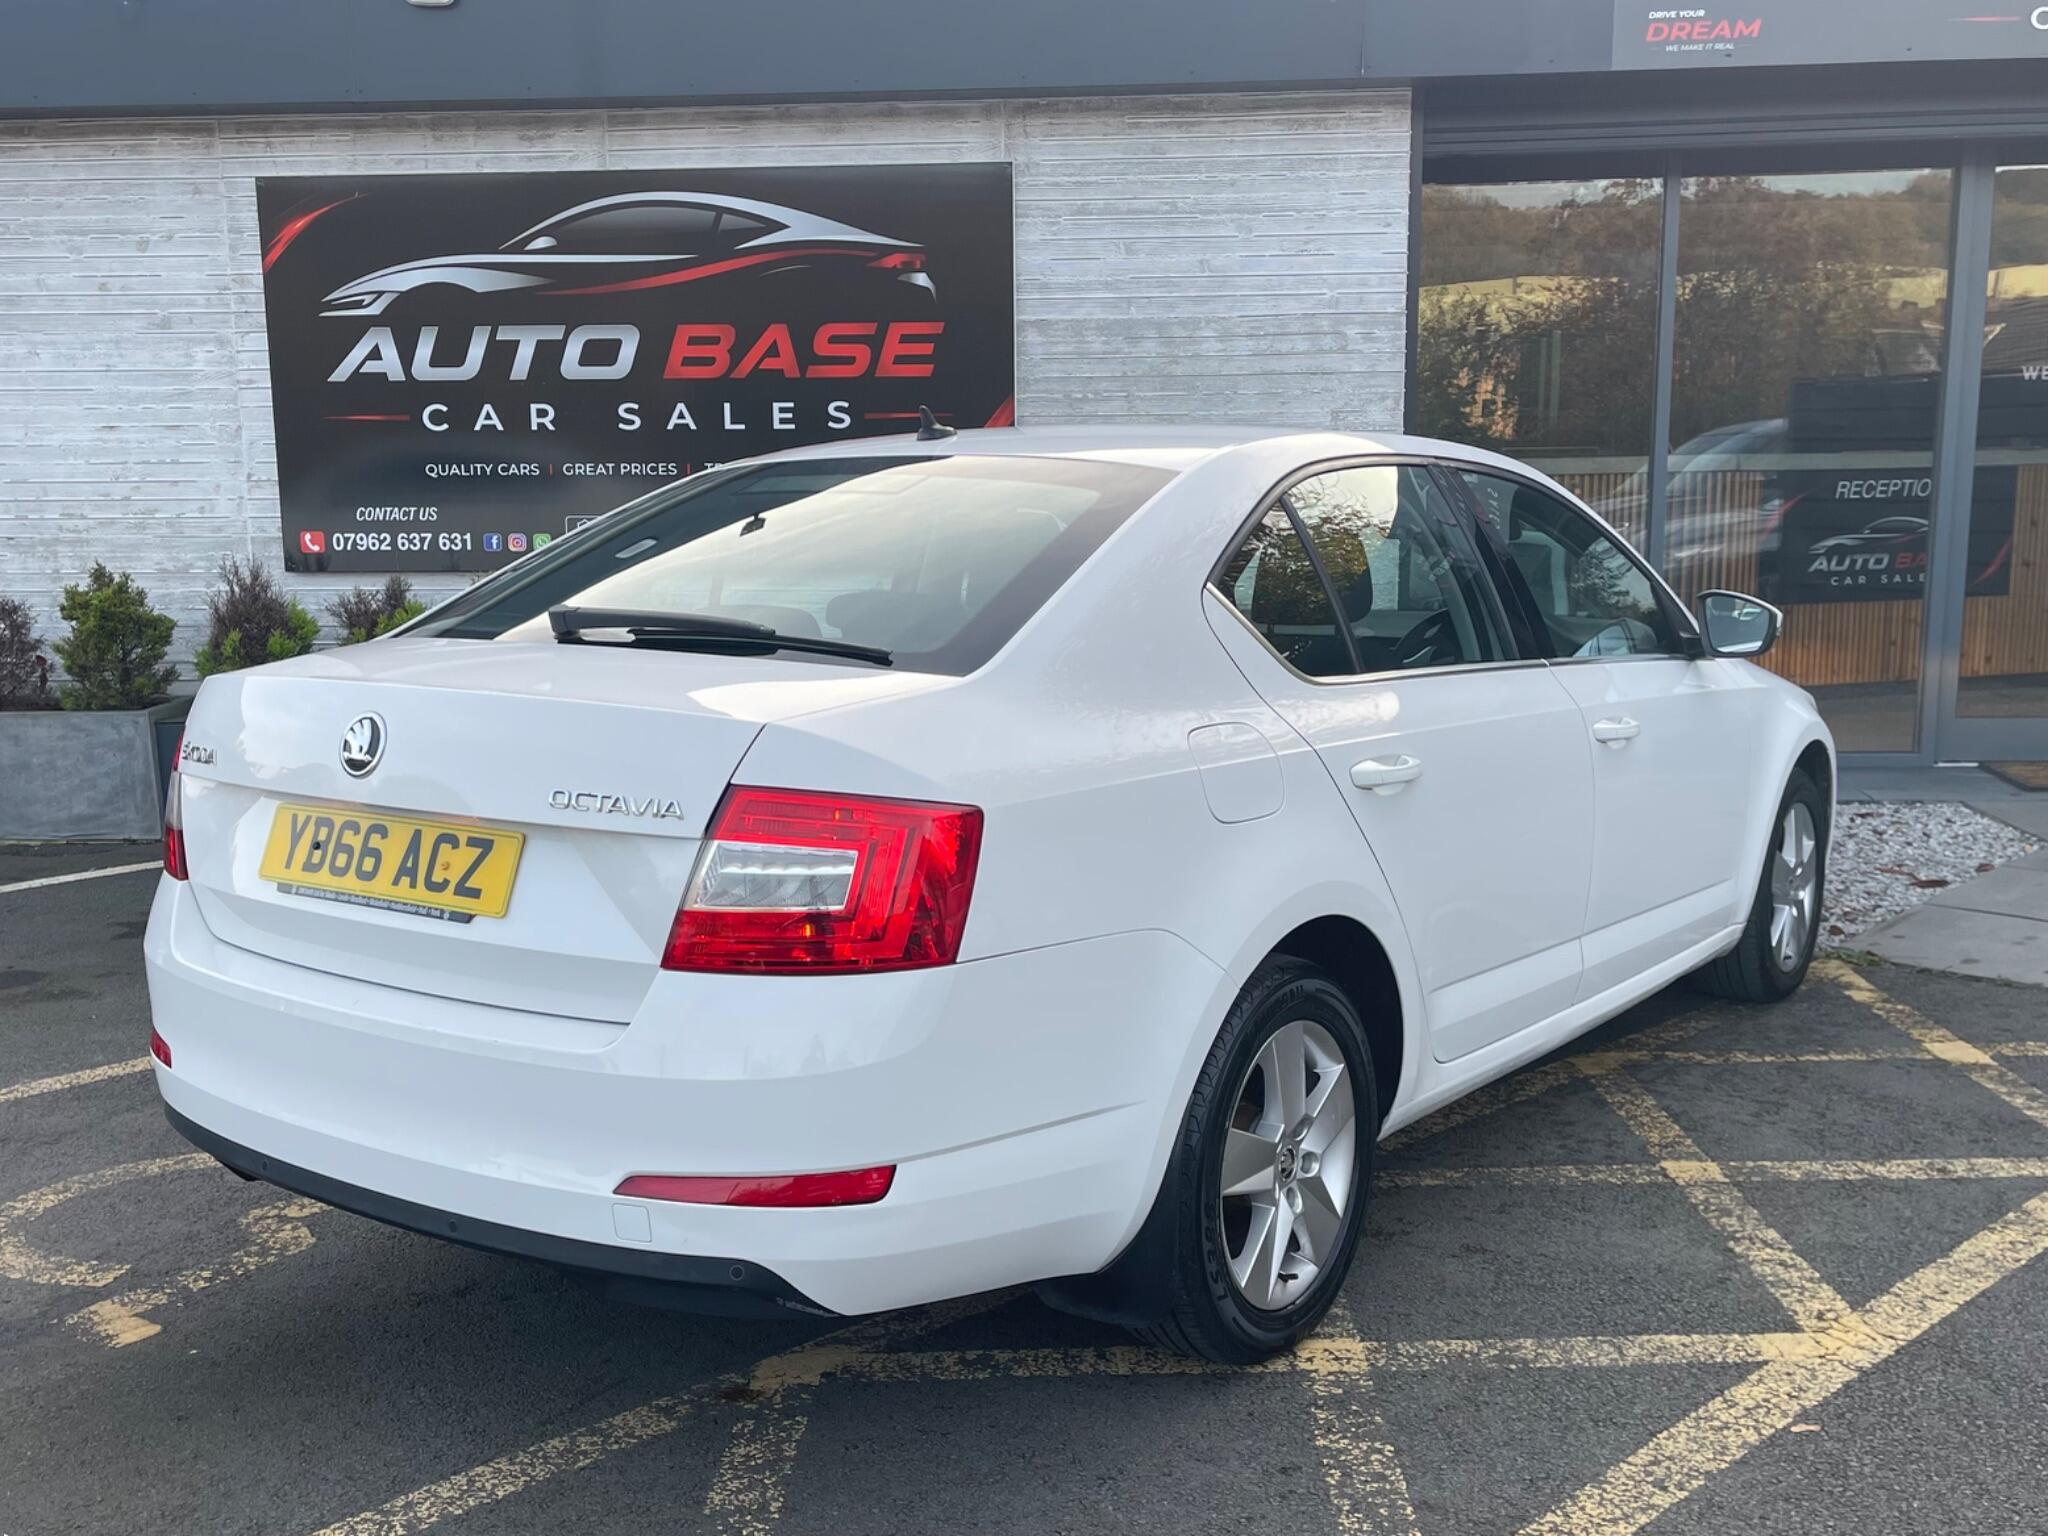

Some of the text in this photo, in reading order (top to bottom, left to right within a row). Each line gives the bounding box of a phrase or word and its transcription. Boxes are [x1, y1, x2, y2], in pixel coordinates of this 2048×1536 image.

[1648, 9, 1706, 19] DRIVE YOUR
[1646, 18, 1762, 42] DREAM
[1665, 42, 1735, 52] WE MAKE IT REAL
[327, 321, 945, 382] AUTO BASE
[421, 401, 852, 431] CAR SALES
[425, 463, 540, 477] QUALITY CARS
[562, 463, 678, 476] GREAT PRICES
[356, 506, 438, 521] CONTACT US
[332, 532, 472, 551] 07962 637 631
[1808, 553, 1890, 572] AUTO
[1830, 575, 1867, 586] CAR
[549, 788, 685, 820] OCTAVIA
[284, 813, 495, 900] YB66 ACZ
